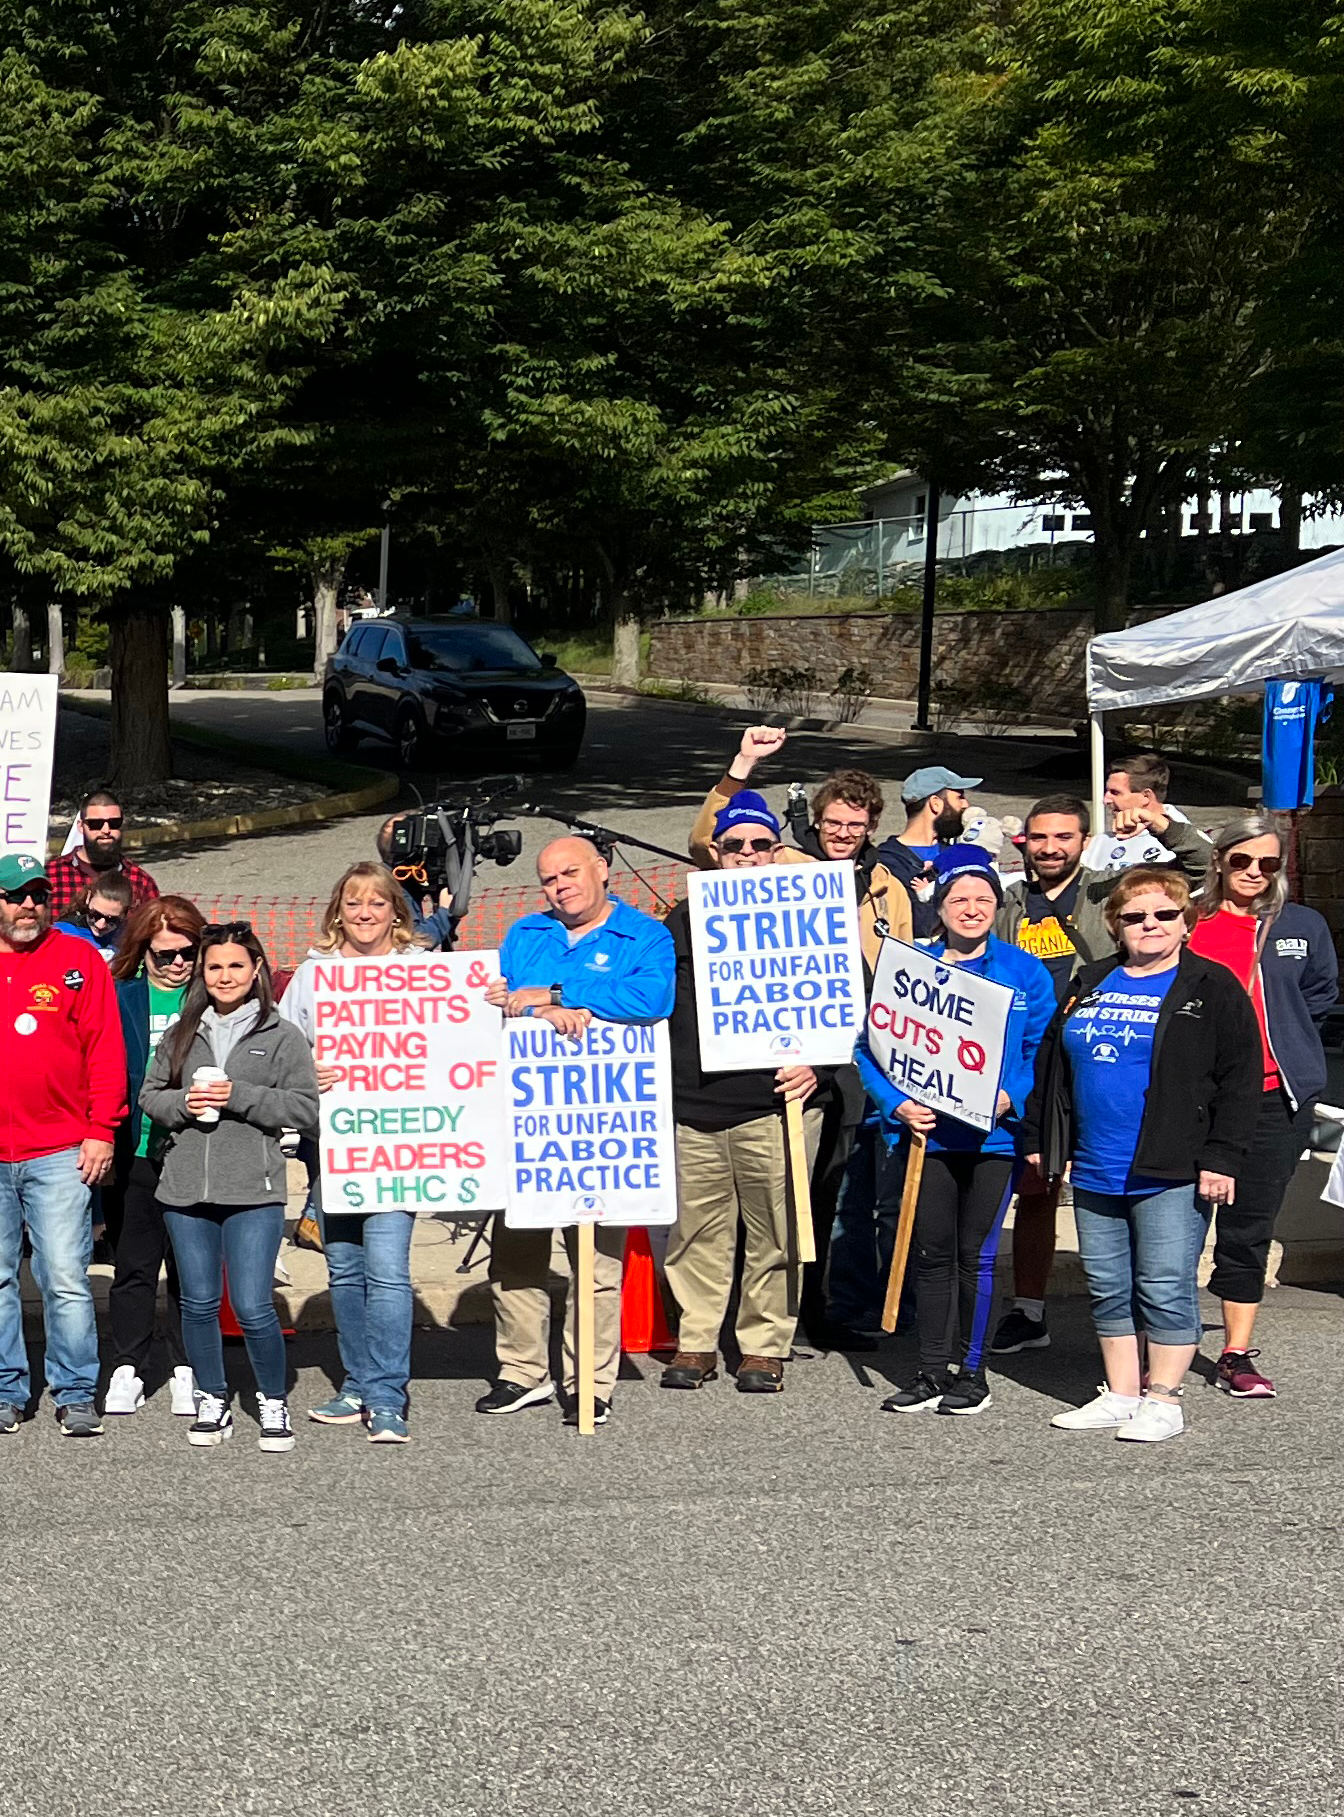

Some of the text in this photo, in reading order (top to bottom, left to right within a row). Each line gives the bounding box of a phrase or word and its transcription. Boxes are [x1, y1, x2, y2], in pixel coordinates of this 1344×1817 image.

[702, 872, 844, 909] NURSES ON
[705, 907, 848, 954] STRIKE
[313, 960, 491, 992] NURSES &
[708, 953, 850, 983] FOR UNFAIR
[711, 979, 852, 1007] LABOR
[316, 996, 471, 1028] PATIENTS
[712, 1003, 854, 1036] PRACTICE
[1075, 1007, 1100, 1018] ON
[316, 1032, 428, 1061] PAYING
[623, 1025, 655, 1054] ON
[329, 1061, 497, 1092] PRICE OF
[512, 1062, 657, 1108] STRIKE
[888, 1047, 963, 1101] HEAL
[330, 1105, 464, 1135] GREEDY
[514, 1111, 658, 1138] FOR UNFAIR
[327, 1141, 486, 1174] LEADERS
[515, 1138, 658, 1163] LABOR
[376, 1175, 446, 1203] HHC
[516, 1164, 660, 1194] PRACTICE
